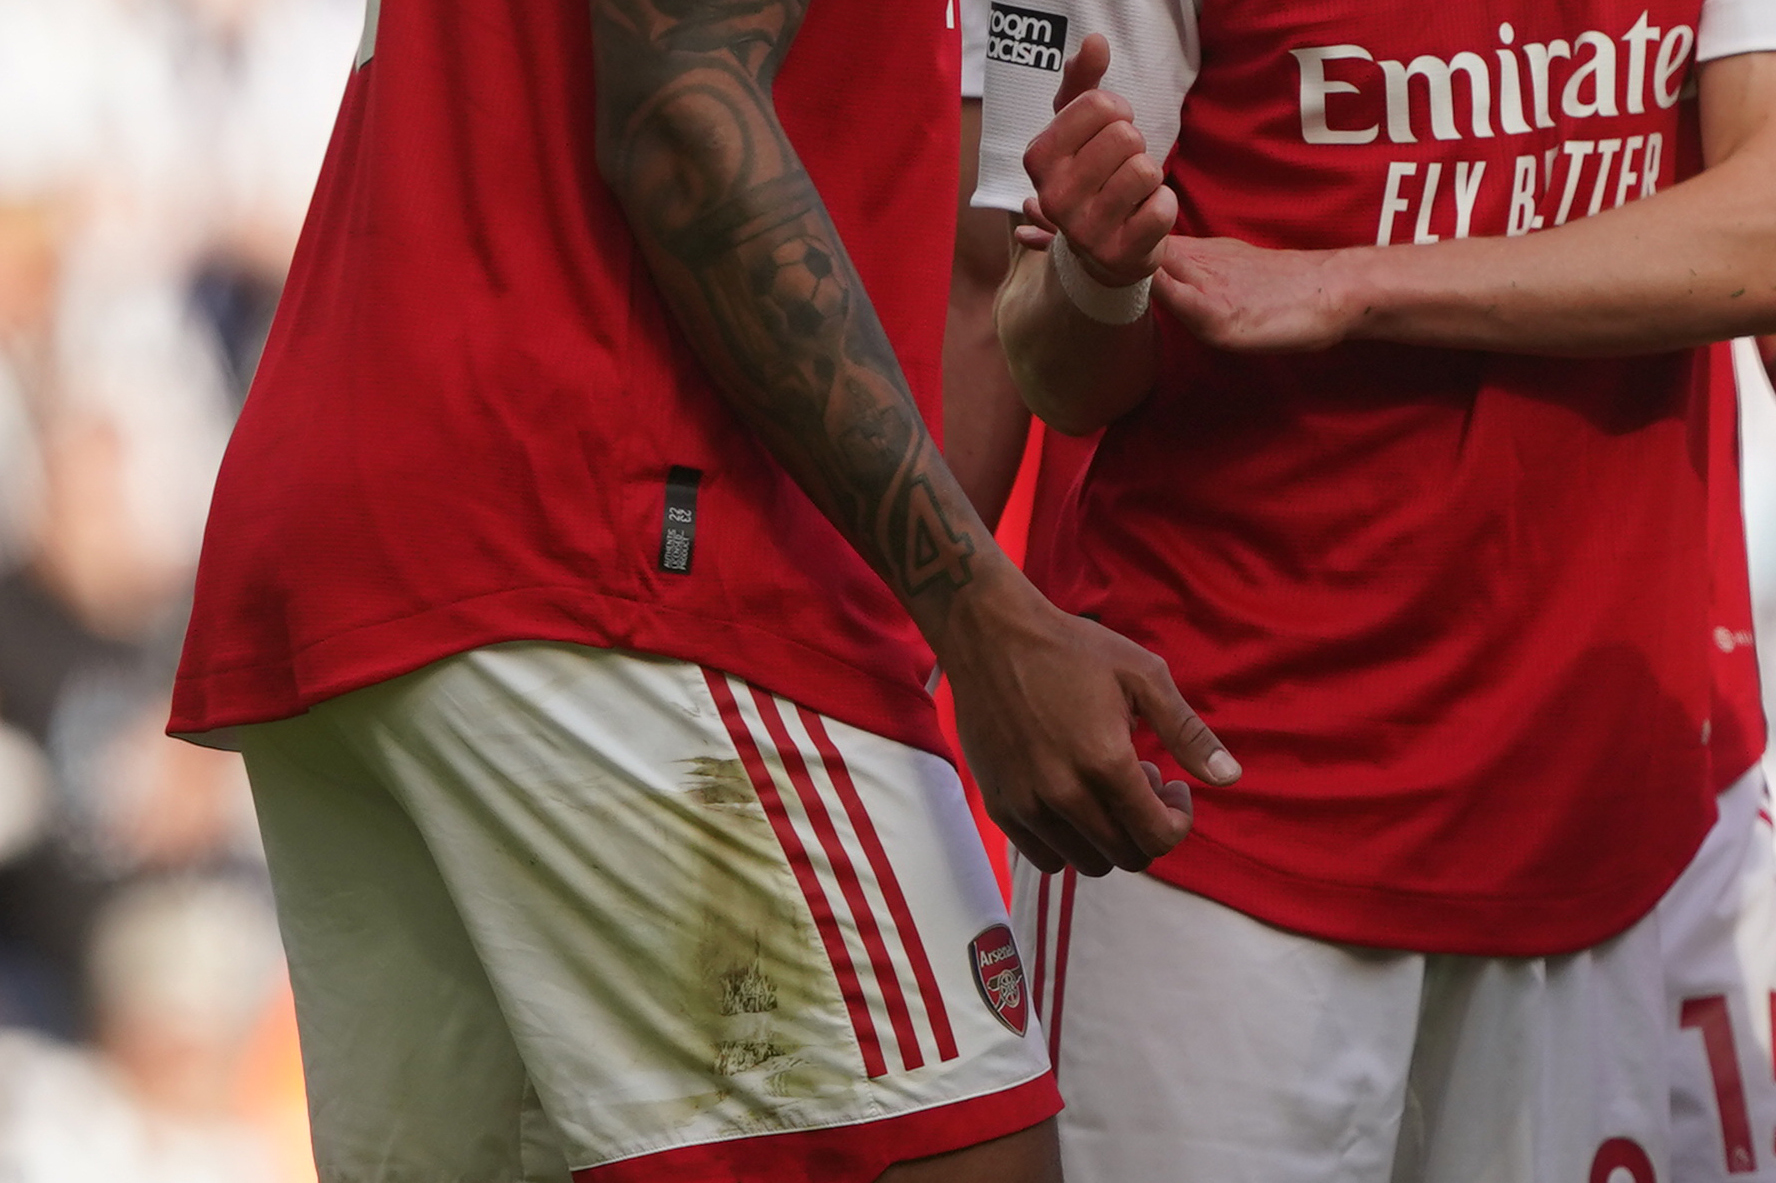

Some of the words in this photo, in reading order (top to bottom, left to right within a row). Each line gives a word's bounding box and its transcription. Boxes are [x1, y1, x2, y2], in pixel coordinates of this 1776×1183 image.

[987, 35, 1062, 70] acism
[1288, 9, 1694, 144] Emirate
[1376, 160, 1487, 247] FLY
